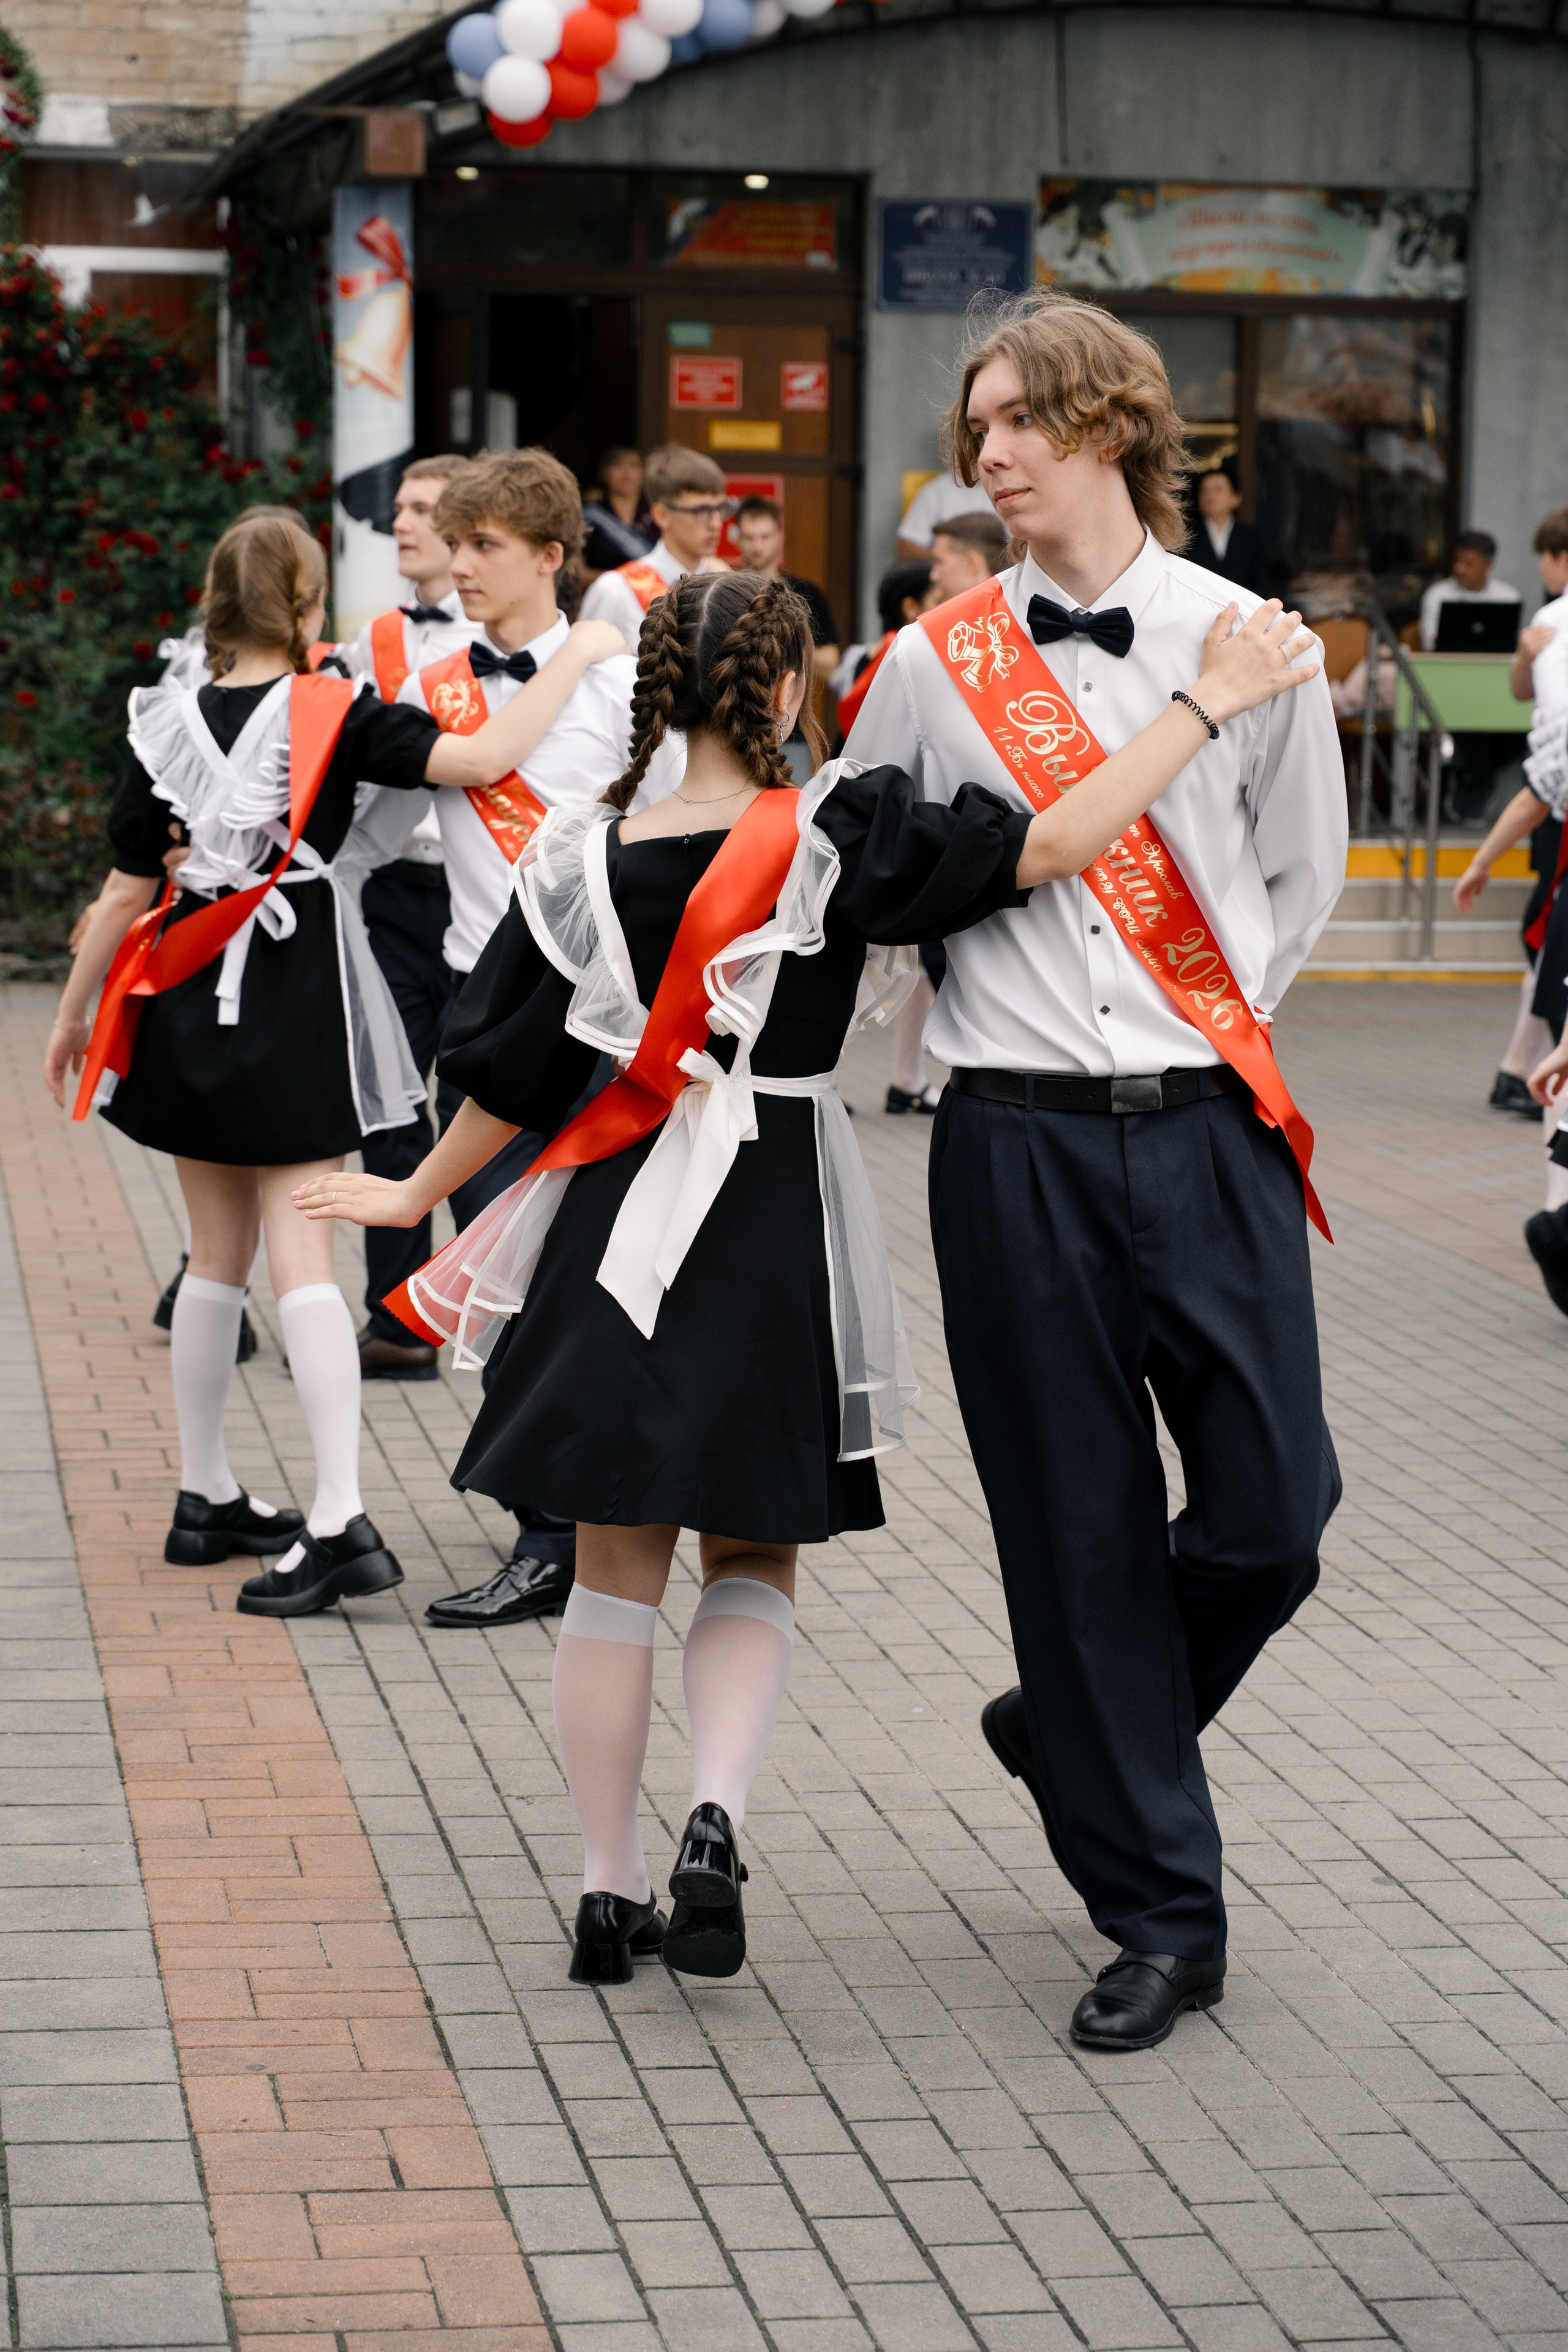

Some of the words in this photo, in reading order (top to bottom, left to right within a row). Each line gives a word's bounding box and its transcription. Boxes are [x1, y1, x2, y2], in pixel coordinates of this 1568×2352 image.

[993, 726, 1014, 741] 11
[1022, 771, 1044, 798] класс
[1112, 897, 1141, 934] СОШ
[1141, 840, 1184, 900] Ярослав
[1160, 927, 1243, 1030] 2026
